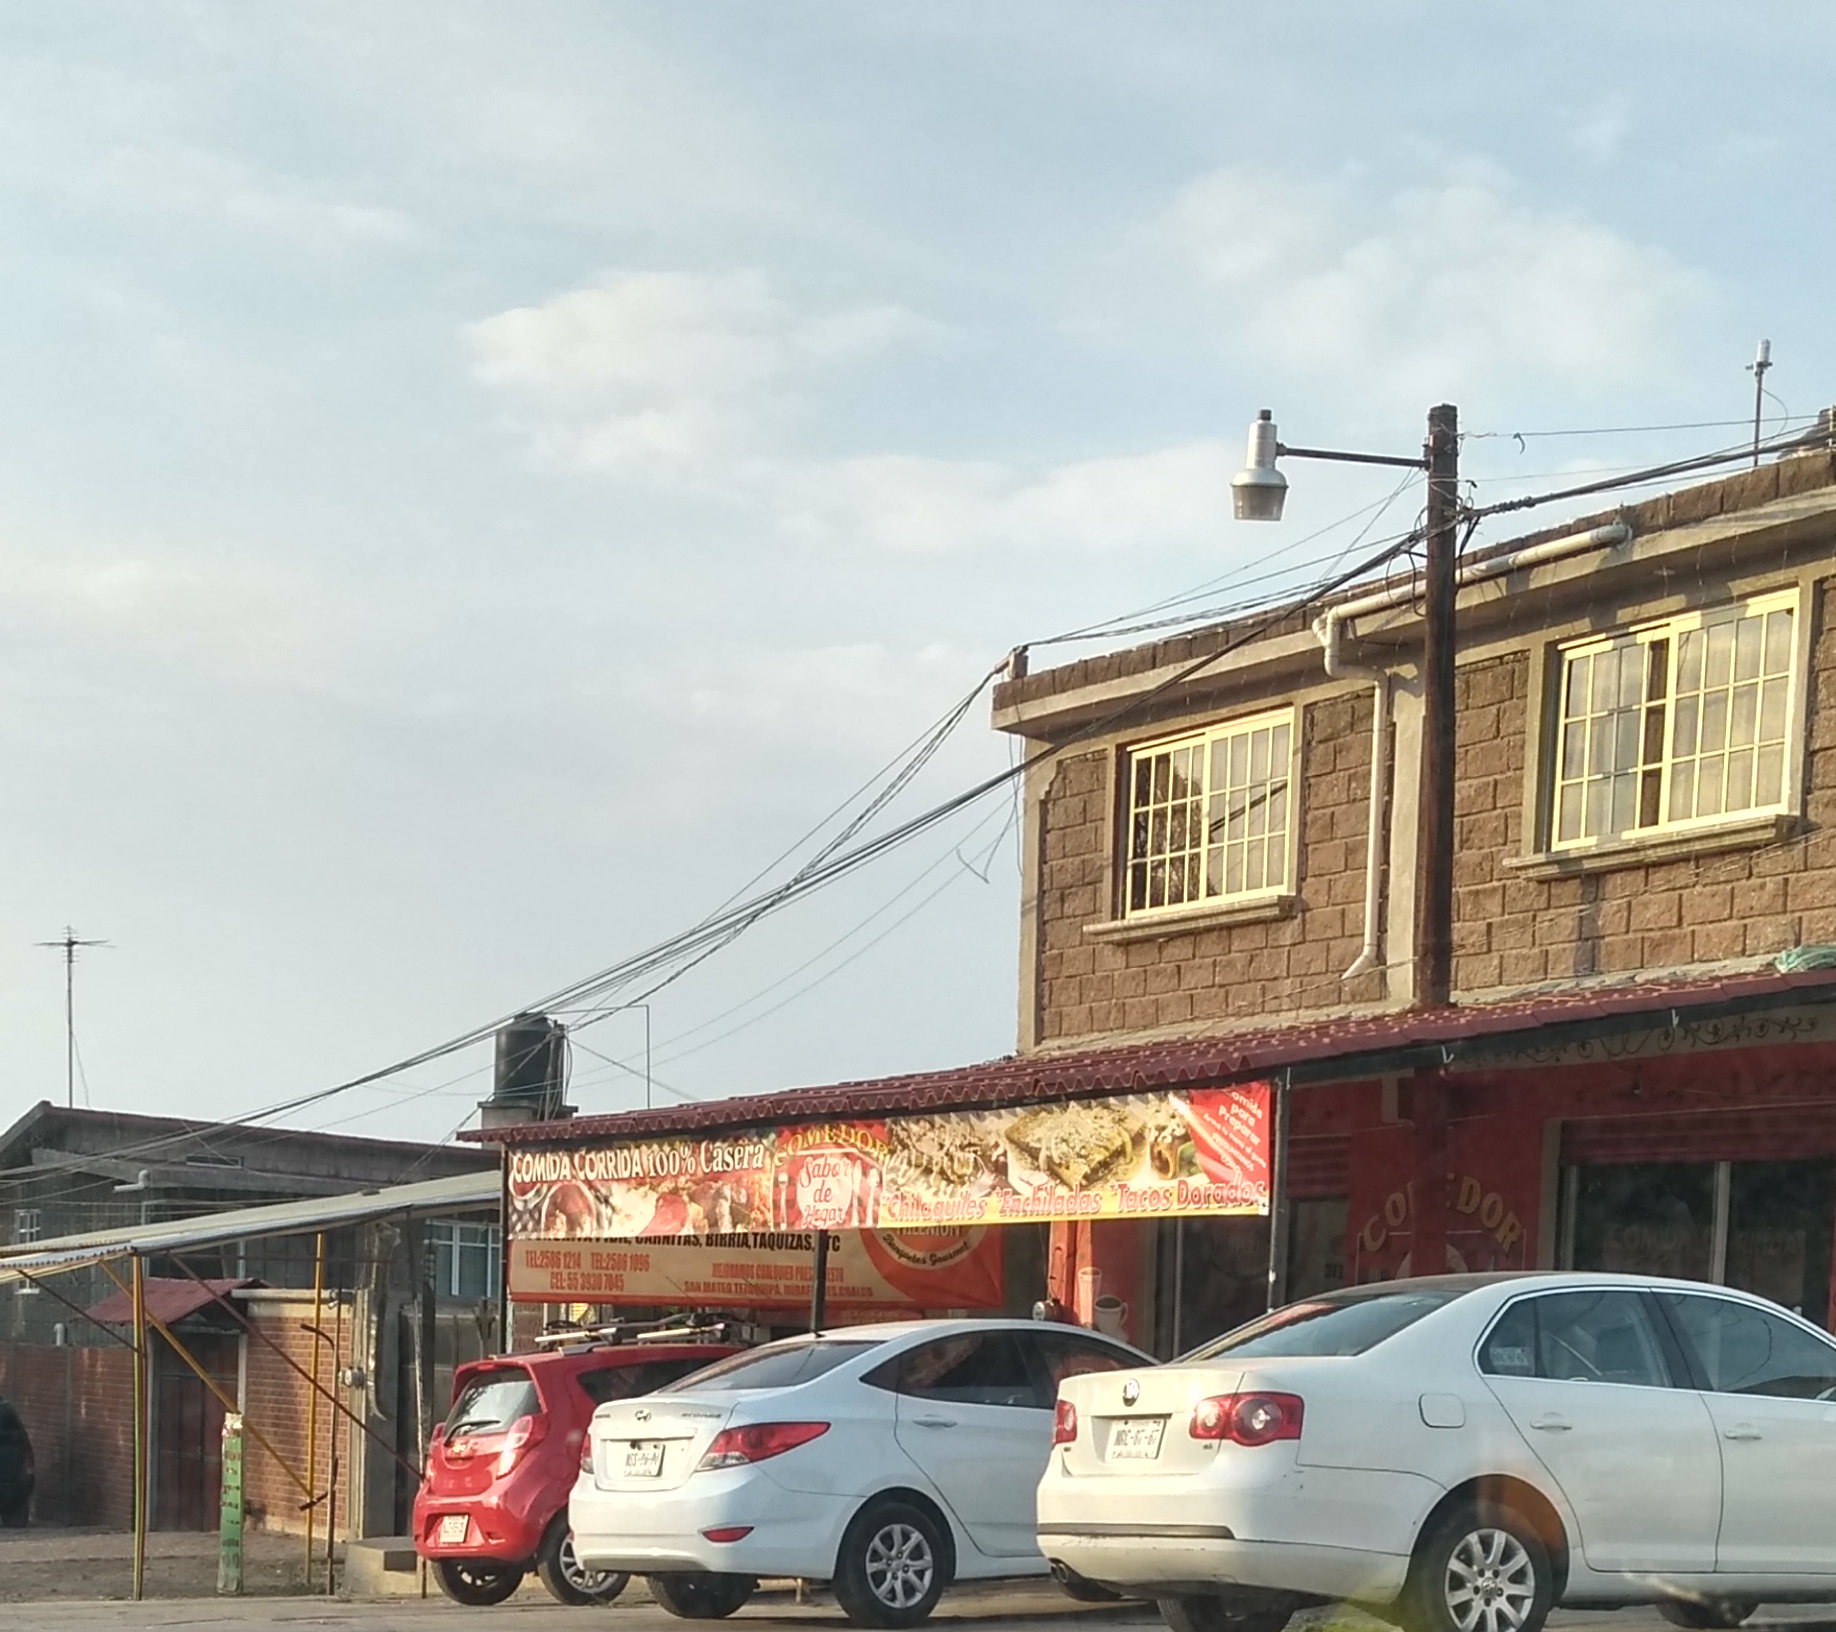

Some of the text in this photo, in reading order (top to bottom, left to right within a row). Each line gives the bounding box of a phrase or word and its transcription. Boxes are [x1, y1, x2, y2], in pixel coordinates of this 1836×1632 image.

[1218, 1104, 1261, 1146] Preparar
[1230, 1103, 1256, 1127] para
[512, 1139, 765, 1183] COMIDA CORRIDA 100% Casera
[773, 1122, 889, 1166] COMEDOR
[800, 1154, 851, 1189] Sabor
[813, 1179, 834, 1204] de
[887, 1167, 1267, 1223] Chilaquiles Enchiladas Tacos Dorados
[1362, 1174, 1522, 1259] CODOR
